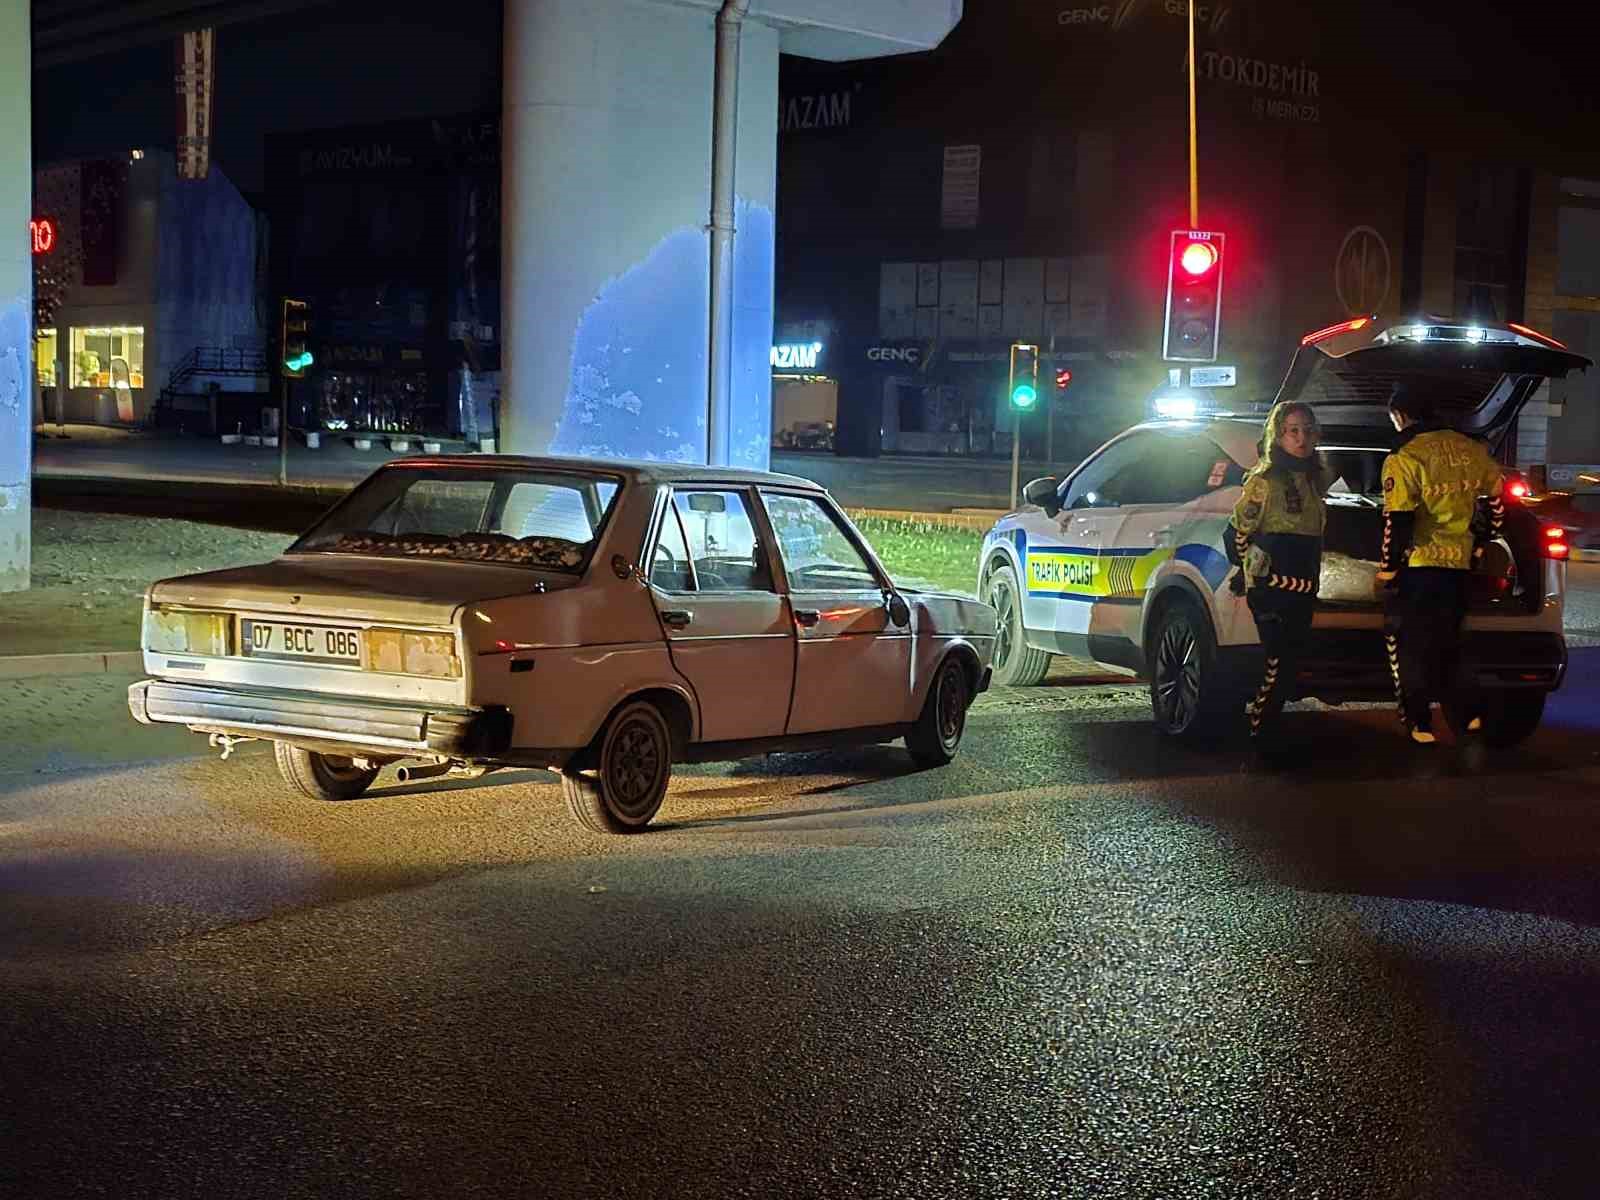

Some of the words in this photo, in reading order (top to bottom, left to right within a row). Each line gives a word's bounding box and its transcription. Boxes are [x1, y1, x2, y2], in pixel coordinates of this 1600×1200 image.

[1179, 51, 1320, 97] TOKDEMİR
[779, 92, 850, 130] AZAM
[1032, 559, 1060, 583] TRAFİK
[1063, 560, 1093, 586] POLİSİ
[253, 624, 273, 649] 07
[284, 627, 314, 652] BCC
[326, 630, 358, 656] 086
